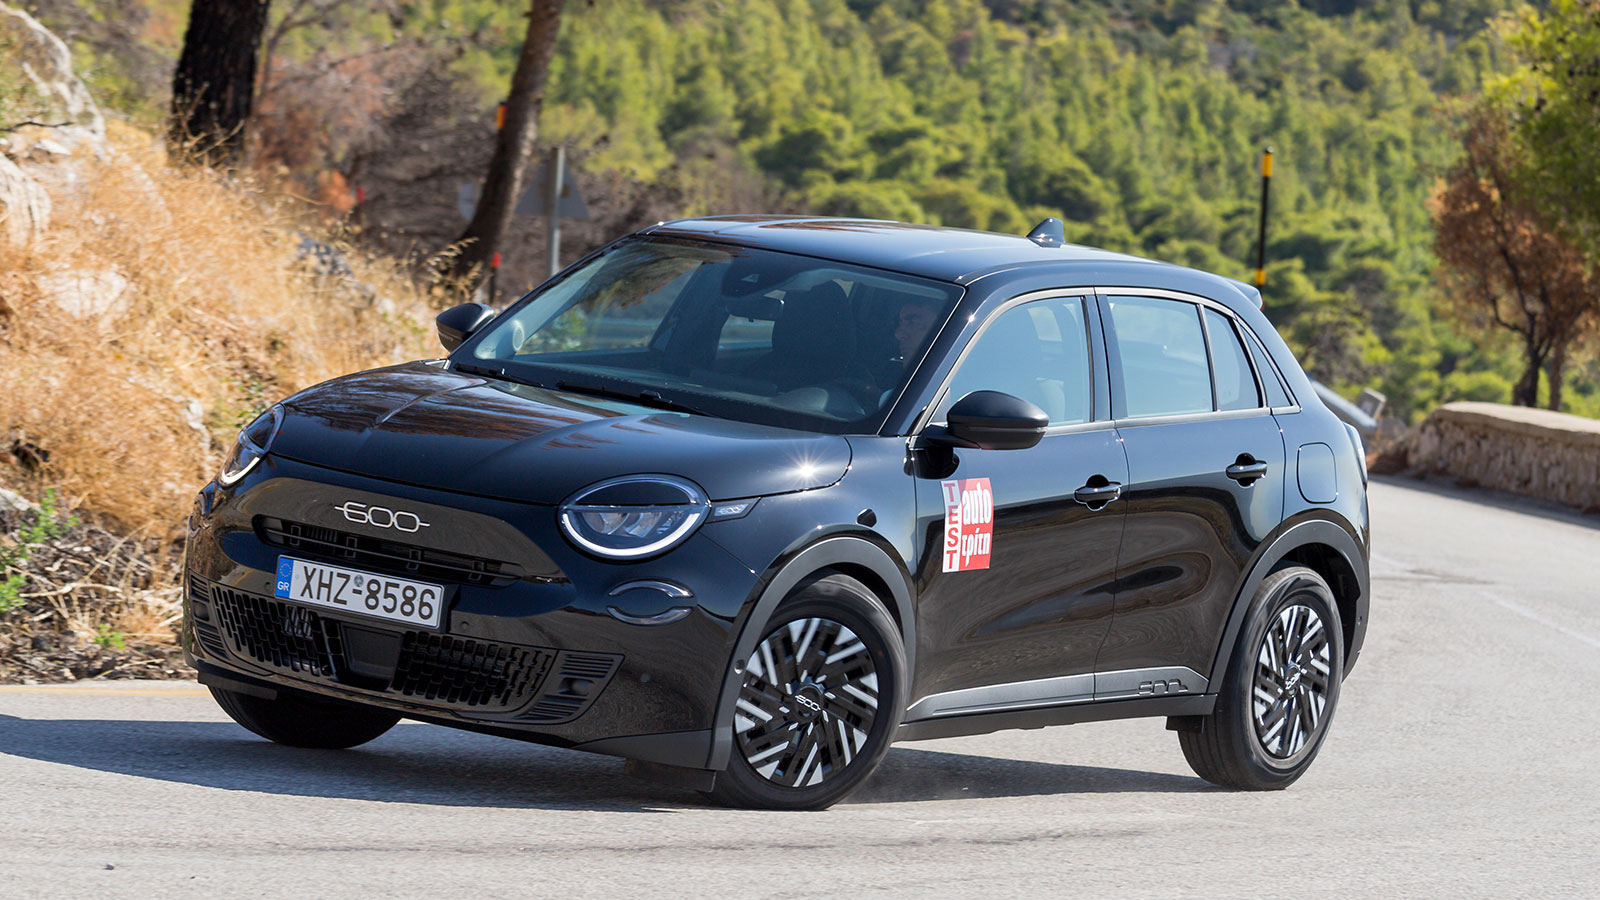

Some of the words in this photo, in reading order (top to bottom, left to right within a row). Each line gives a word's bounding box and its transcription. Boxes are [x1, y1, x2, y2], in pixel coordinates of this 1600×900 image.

[334, 501, 431, 533] 600
[961, 481, 993, 526] auto
[943, 482, 960, 570] TEST
[277, 580, 290, 592] GR
[300, 565, 436, 620] XHZ-8586
[794, 694, 822, 712] 600
